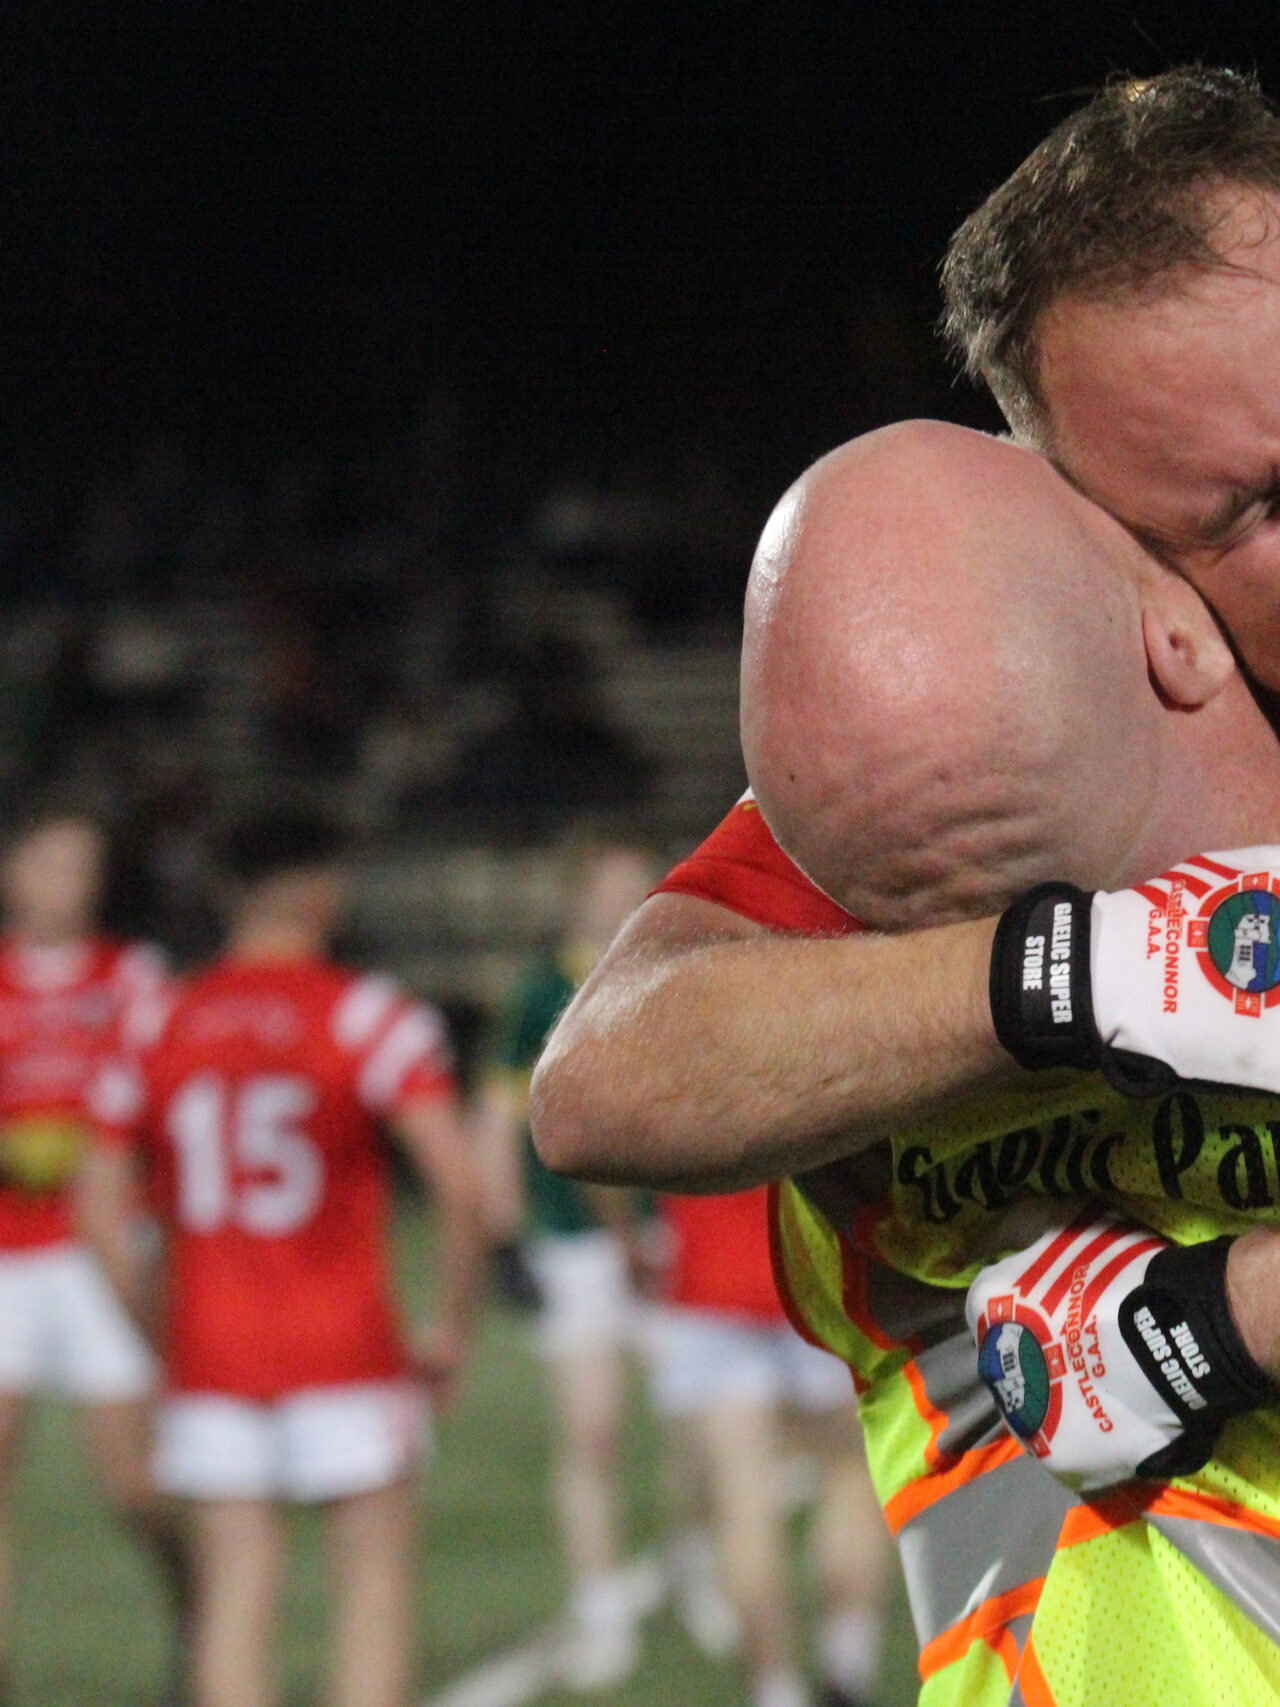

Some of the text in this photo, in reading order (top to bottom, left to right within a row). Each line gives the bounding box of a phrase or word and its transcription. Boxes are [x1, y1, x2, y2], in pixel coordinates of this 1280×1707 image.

[1023, 935, 1045, 990] STORE
[1050, 902, 1073, 1023] GAELIC SUPER
[1147, 908, 1162, 960] G.A.A.
[167, 1072, 324, 1236] 15
[1066, 1264, 1113, 1432] CASTLECONNOR
[1085, 1315, 1106, 1377] G.A.A.
[1134, 1306, 1207, 1410] GAELIC SUPER
[1170, 1321, 1210, 1378] STORE
